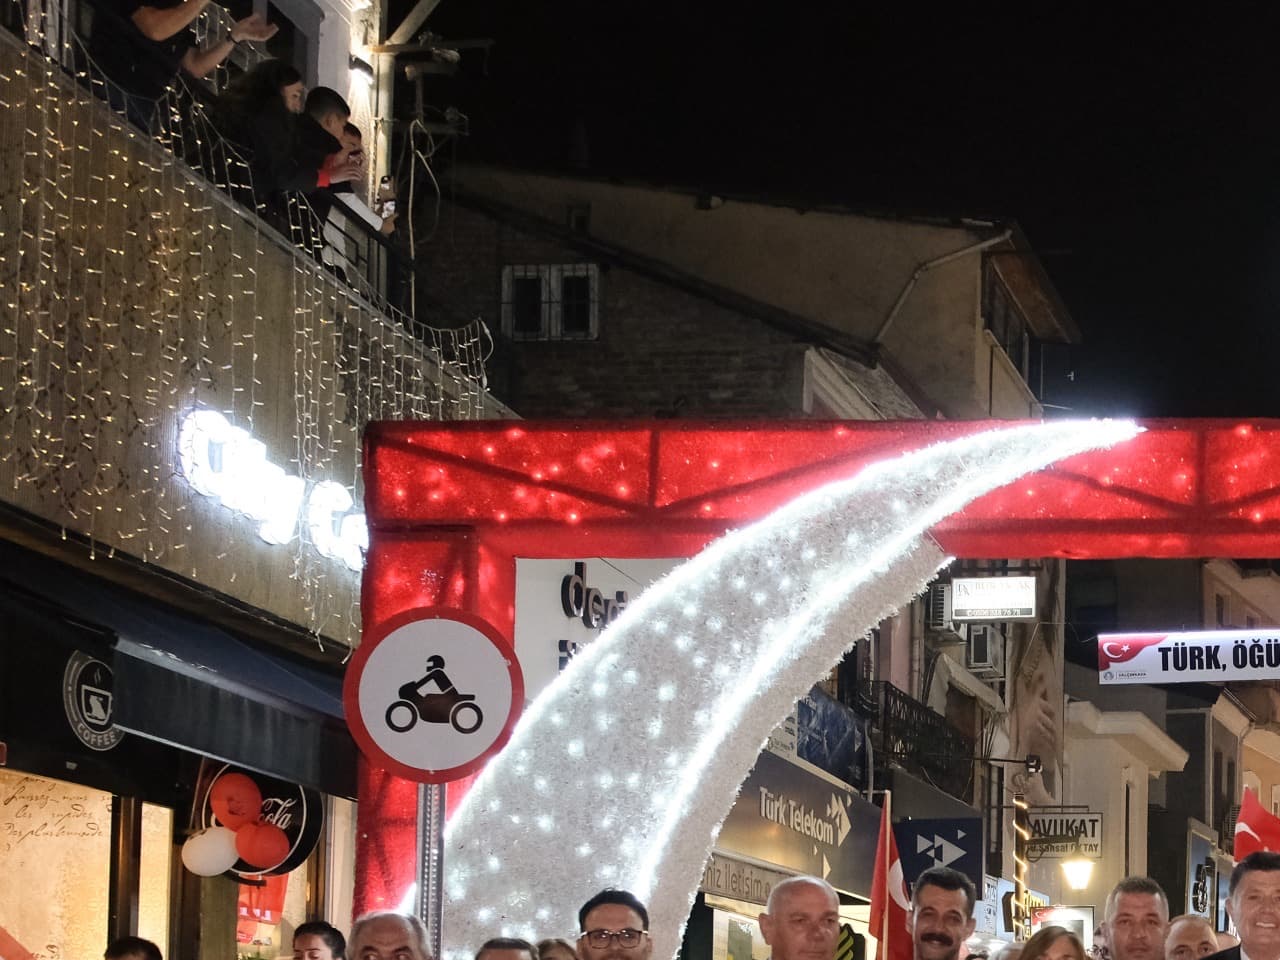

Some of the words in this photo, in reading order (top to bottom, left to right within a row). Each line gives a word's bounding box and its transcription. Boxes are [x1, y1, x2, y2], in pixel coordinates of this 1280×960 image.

[1158, 642, 1227, 672] TÜRK,
[77, 723, 117, 747] COFFEE
[760, 786, 786, 826] Türk
[788, 799, 834, 846] Telekom
[1032, 819, 1099, 838] AVUKAT
[1071, 843, 1099, 853] OTAY
